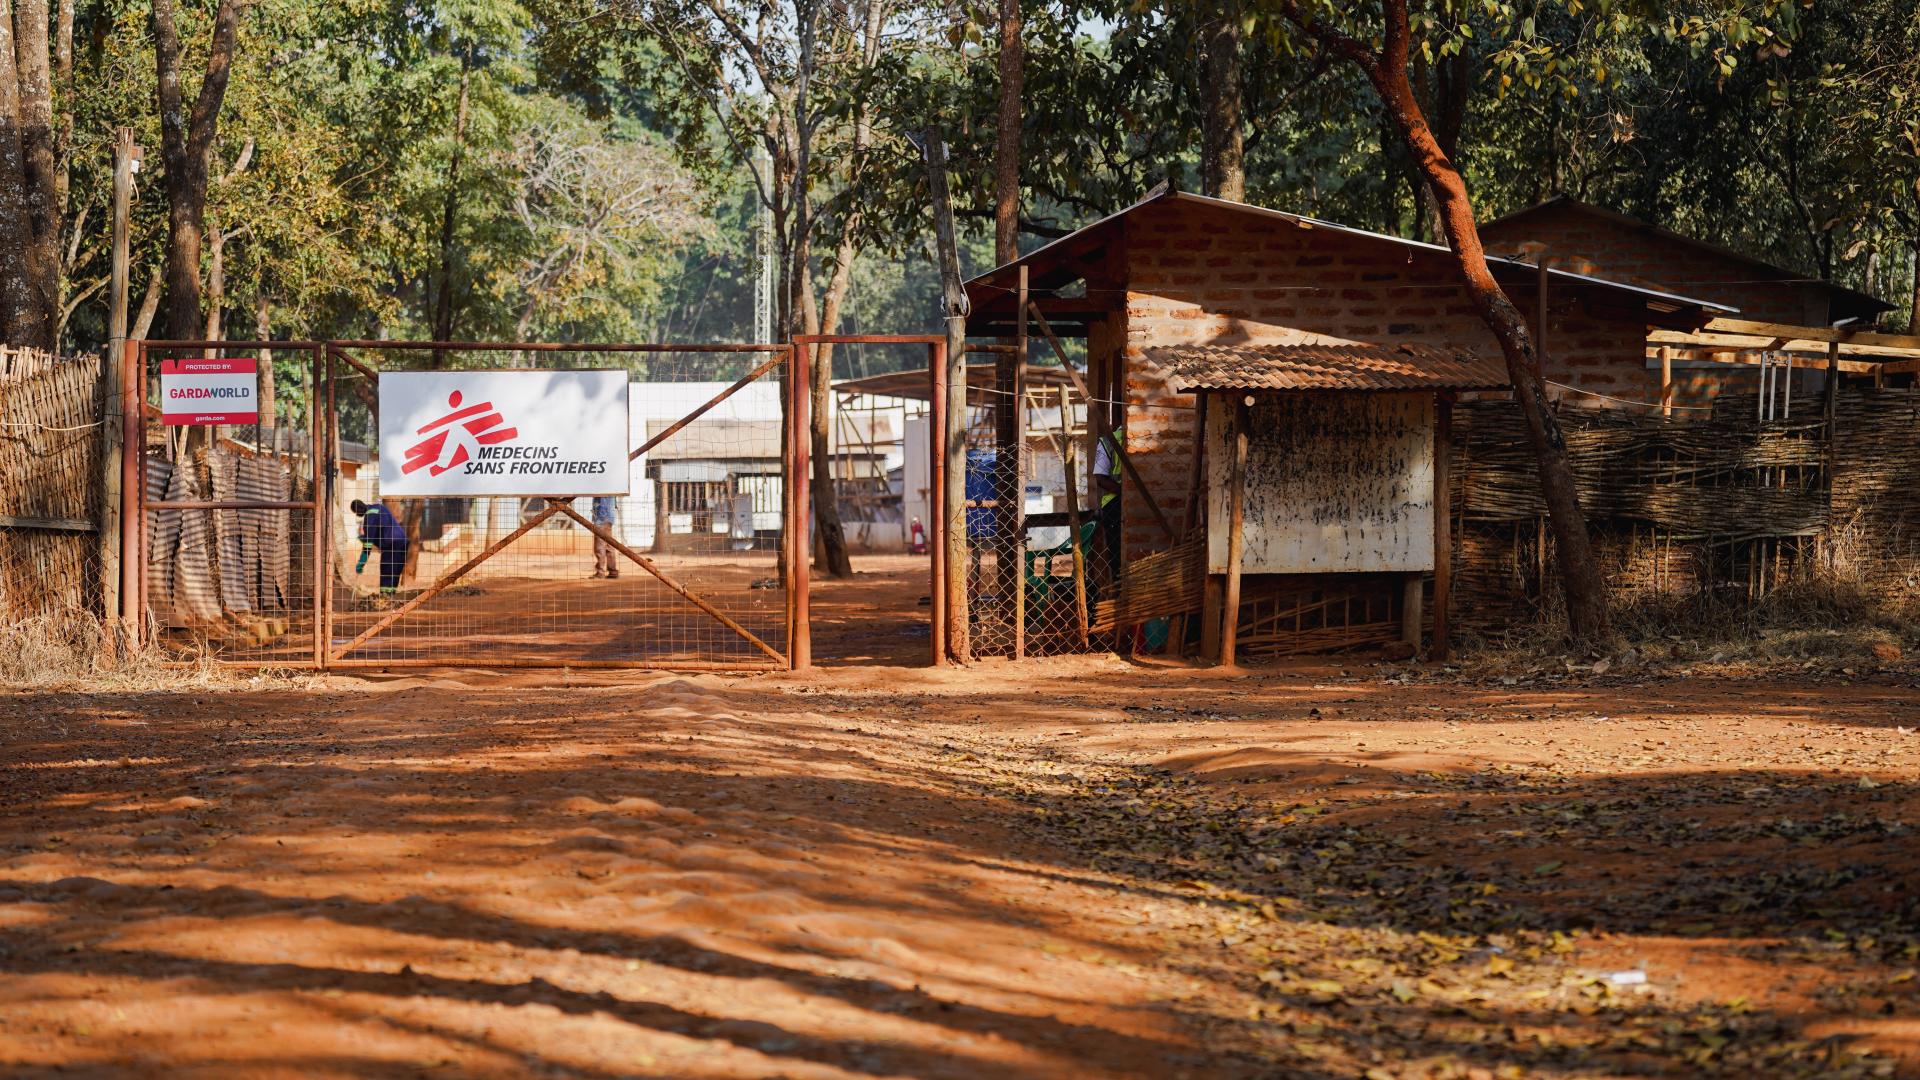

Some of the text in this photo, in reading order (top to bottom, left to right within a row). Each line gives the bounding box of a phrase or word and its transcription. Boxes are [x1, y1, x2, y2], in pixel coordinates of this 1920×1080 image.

[169, 387, 250, 399] GARDAWORLD
[478, 446, 559, 460] MEDECINS
[464, 461, 607, 475] SANS FRONTIERES
